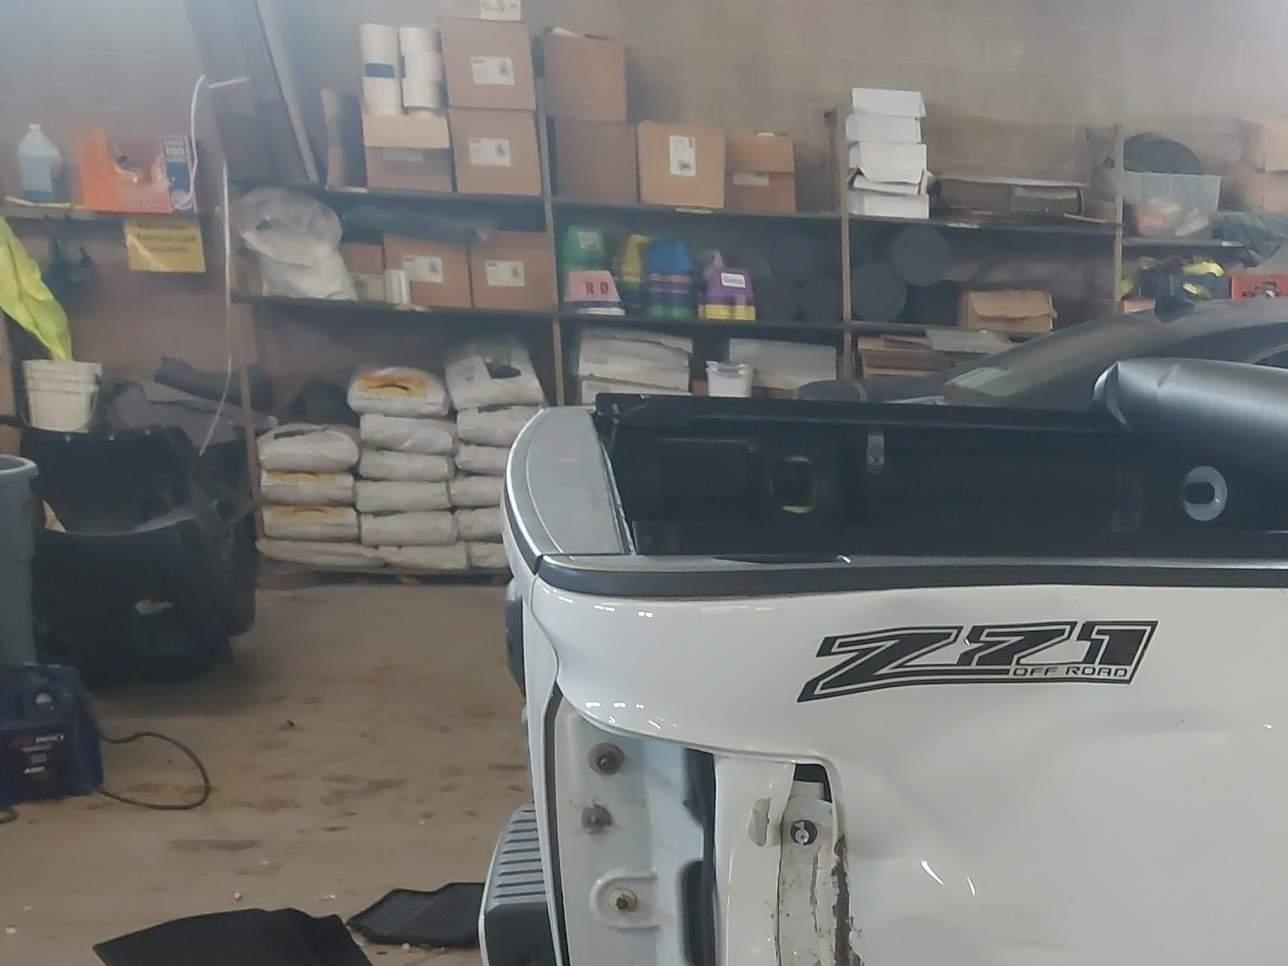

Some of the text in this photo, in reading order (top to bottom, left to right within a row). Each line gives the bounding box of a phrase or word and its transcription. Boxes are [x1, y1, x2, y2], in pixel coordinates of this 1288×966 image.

[796, 620, 1159, 704] Z71
[1012, 666, 1129, 678] OFF ROAD
